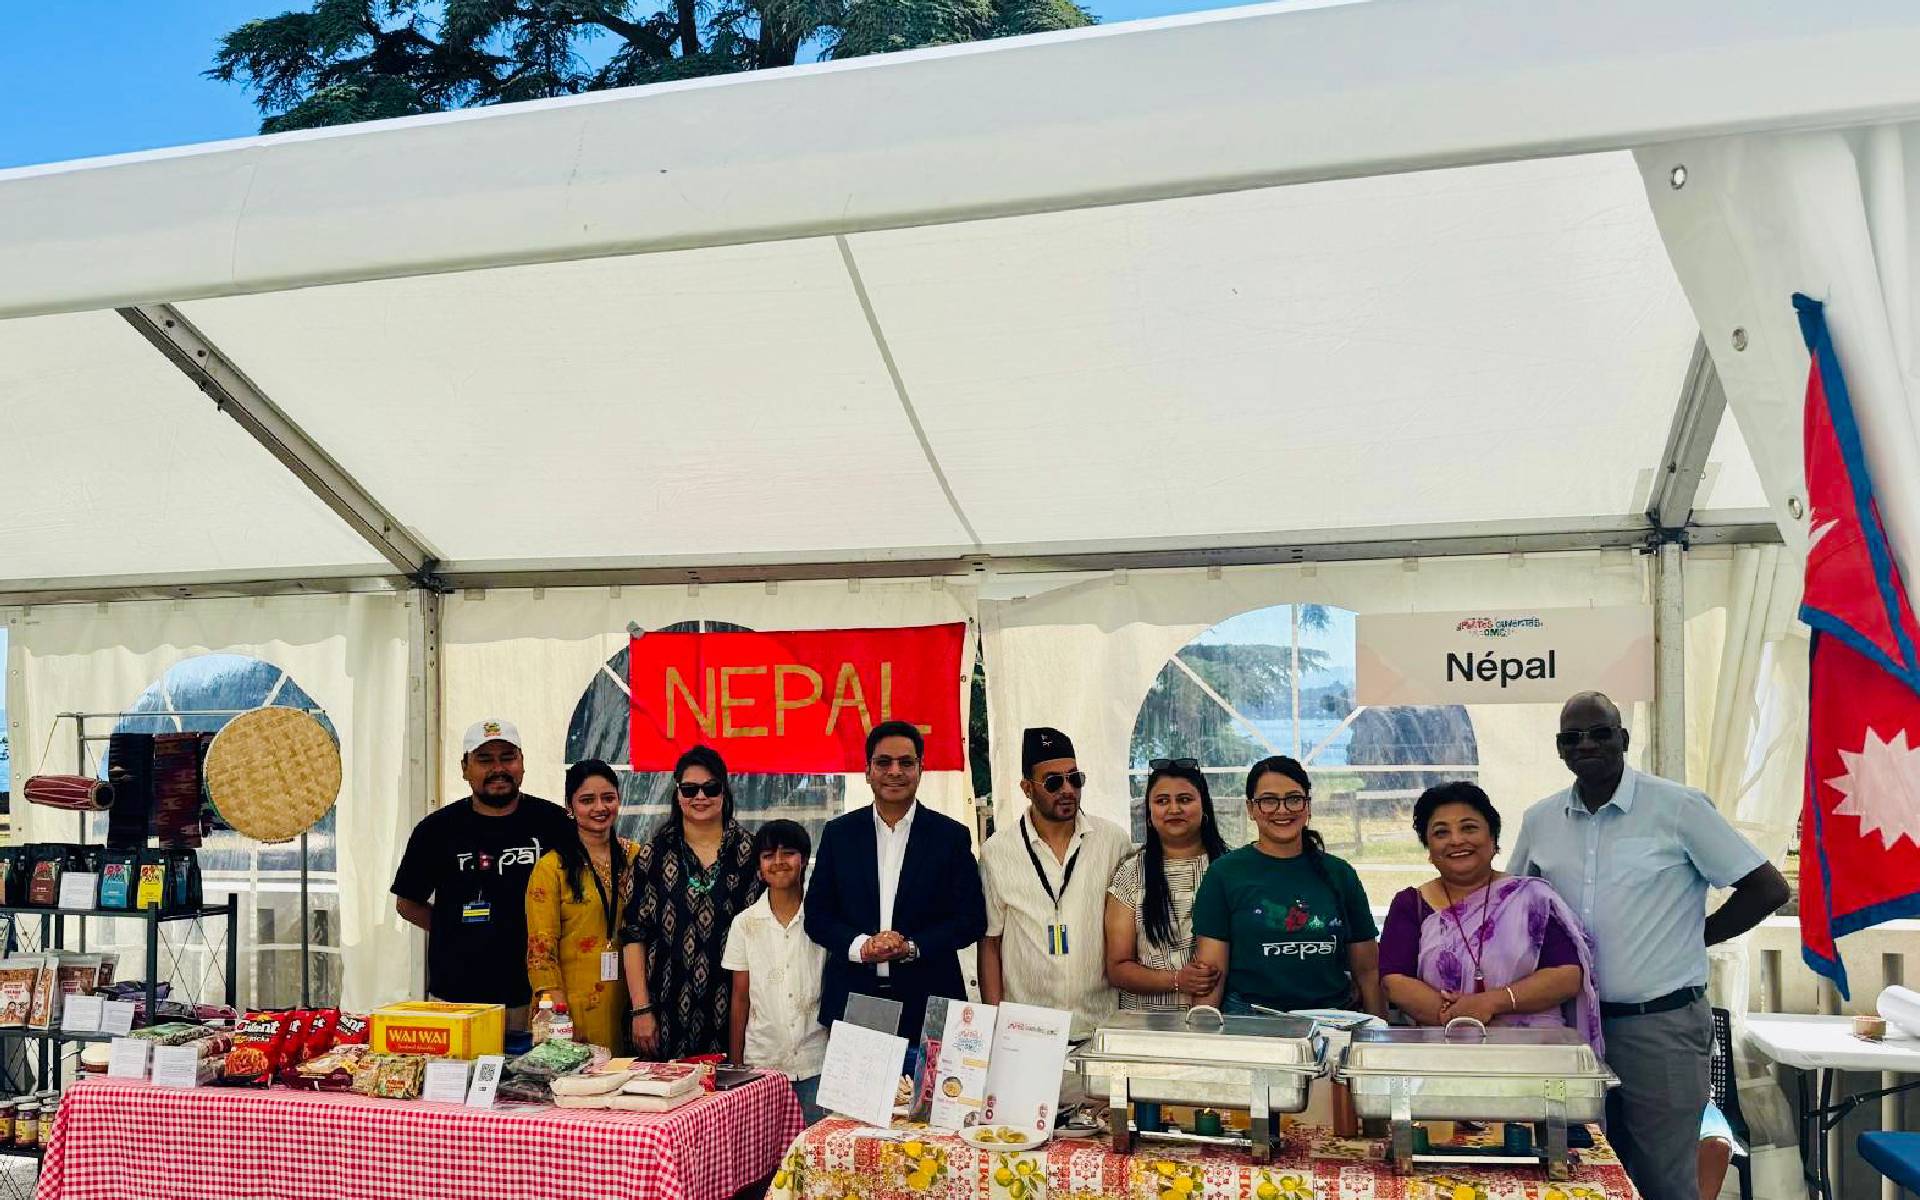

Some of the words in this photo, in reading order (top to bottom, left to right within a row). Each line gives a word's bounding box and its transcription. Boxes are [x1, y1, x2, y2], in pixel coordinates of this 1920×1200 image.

[1446, 649, 1556, 688] Népal
[665, 661, 932, 739] NEPAL
[389, 1029, 417, 1043] WAI
[418, 1030, 447, 1045] WAI
